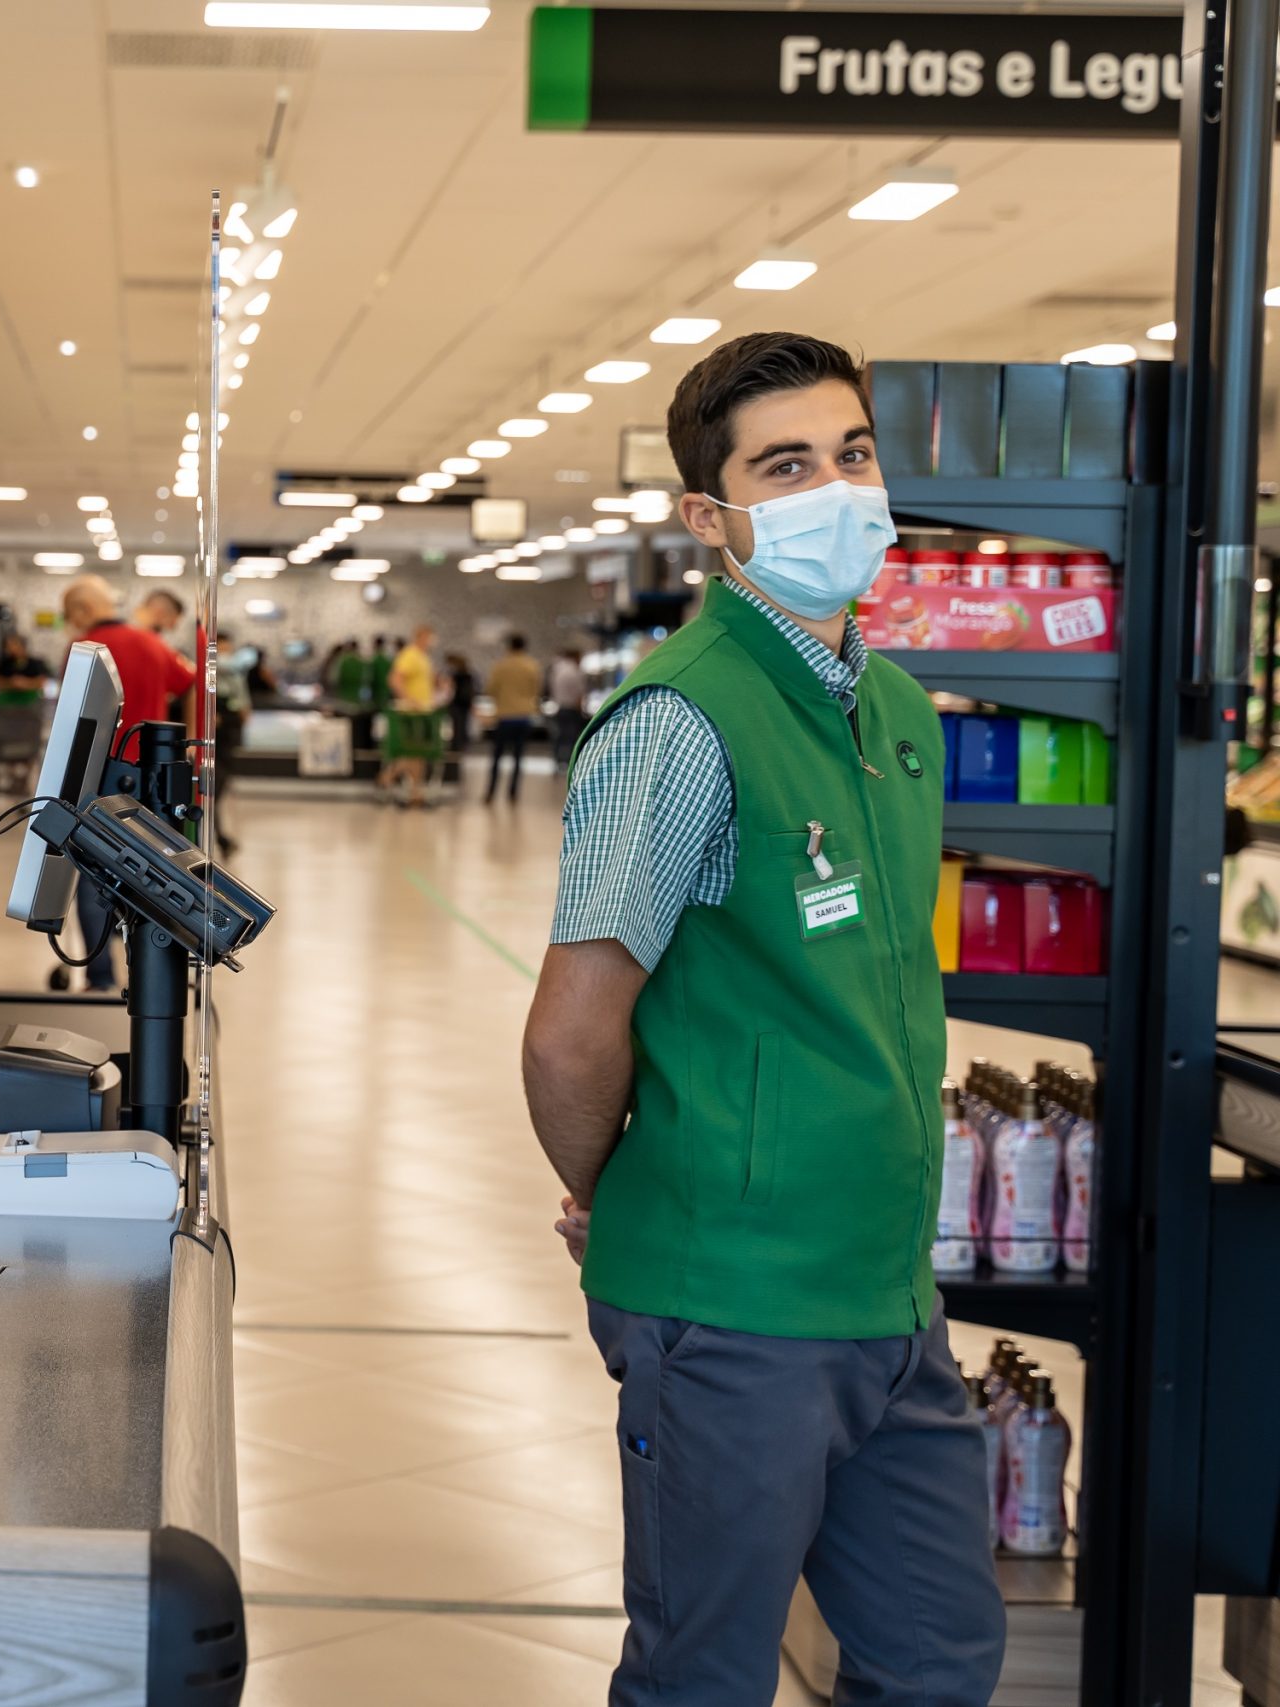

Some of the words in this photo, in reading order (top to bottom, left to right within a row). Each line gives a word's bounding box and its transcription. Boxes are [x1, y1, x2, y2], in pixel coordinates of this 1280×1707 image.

[780, 36, 984, 97] Frutas
[996, 52, 1036, 98] e
[1051, 40, 1185, 115] Legu
[804, 882, 855, 904] MERCADONA
[816, 904, 847, 918] SAMUEL
